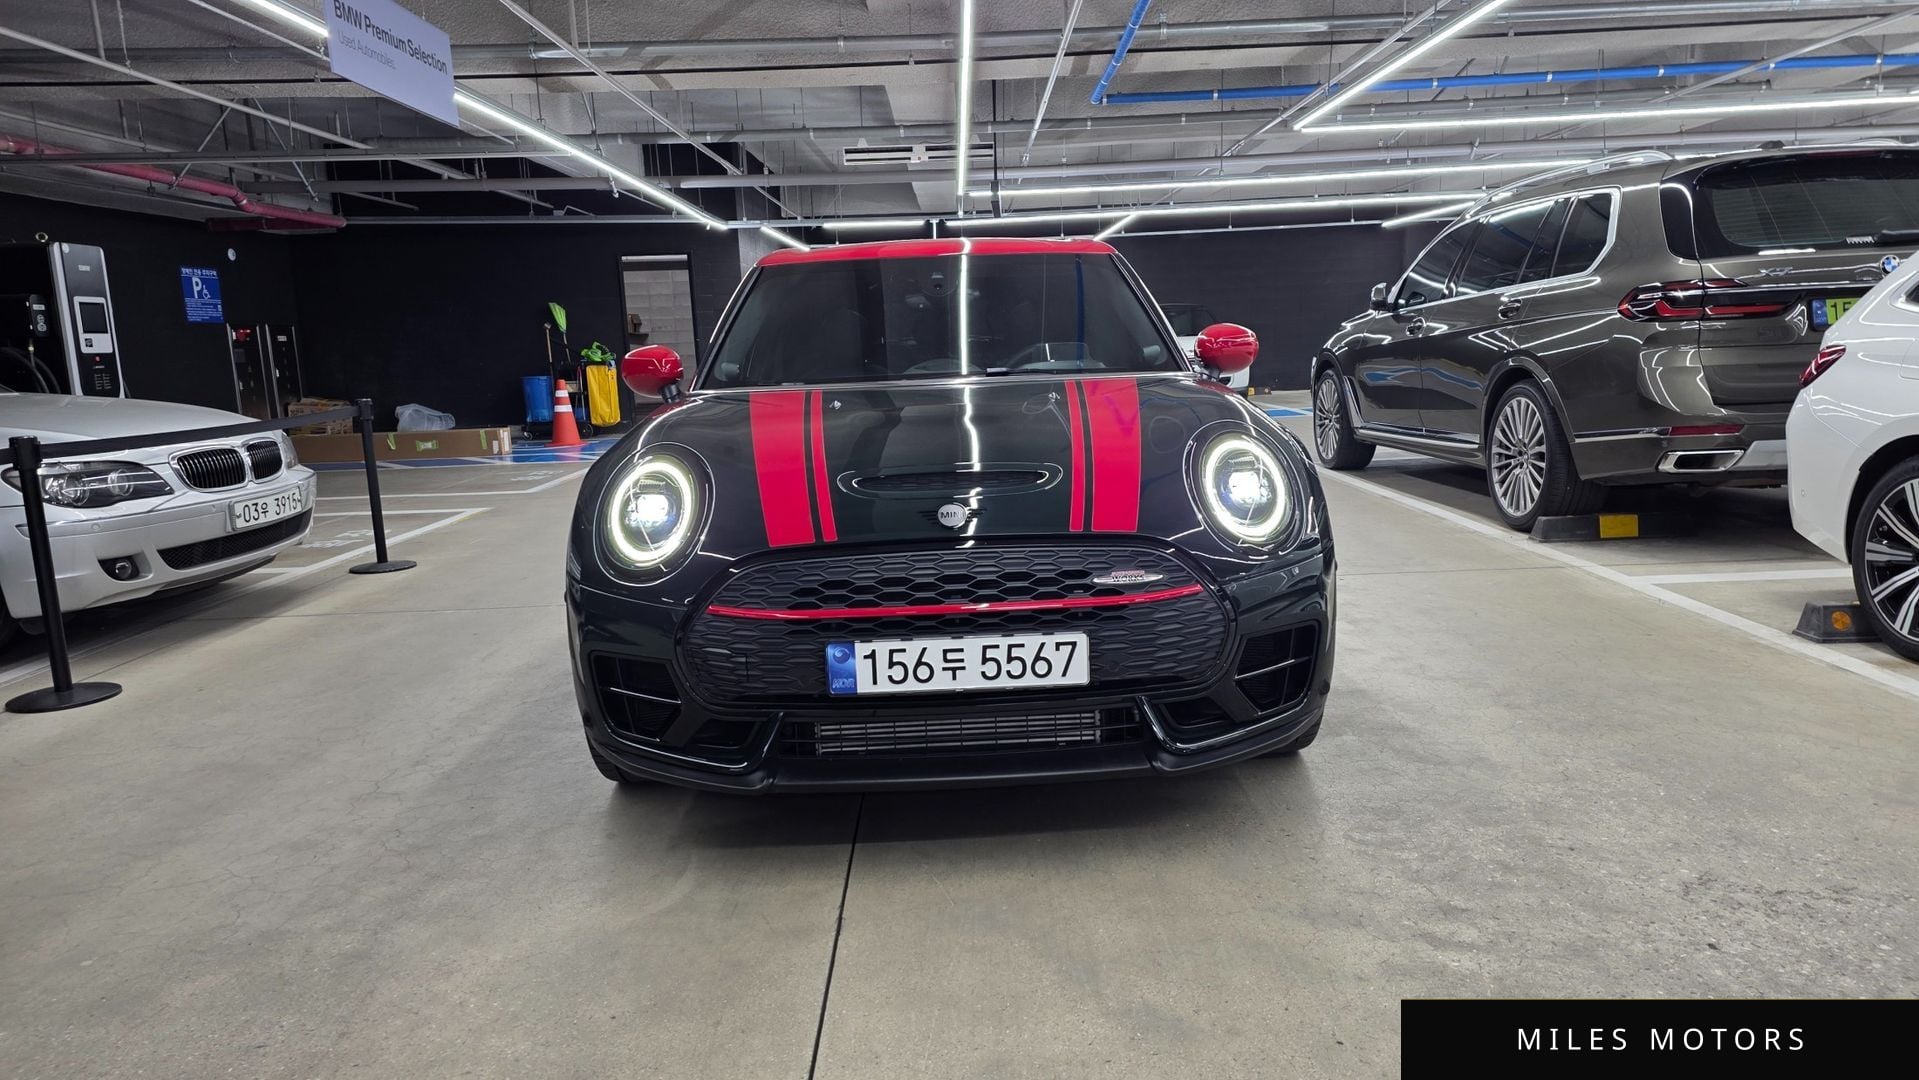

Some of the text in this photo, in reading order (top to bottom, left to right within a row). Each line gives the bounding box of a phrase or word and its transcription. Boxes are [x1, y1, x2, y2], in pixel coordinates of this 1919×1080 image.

[334, 0, 448, 75] BMW Premium Selection
[338, 29, 357, 50] Used
[192, 277, 202, 299] P
[243, 492, 298, 523] 03우 3915
[863, 641, 1078, 686] 156두 5567
[832, 678, 855, 689] KOR
